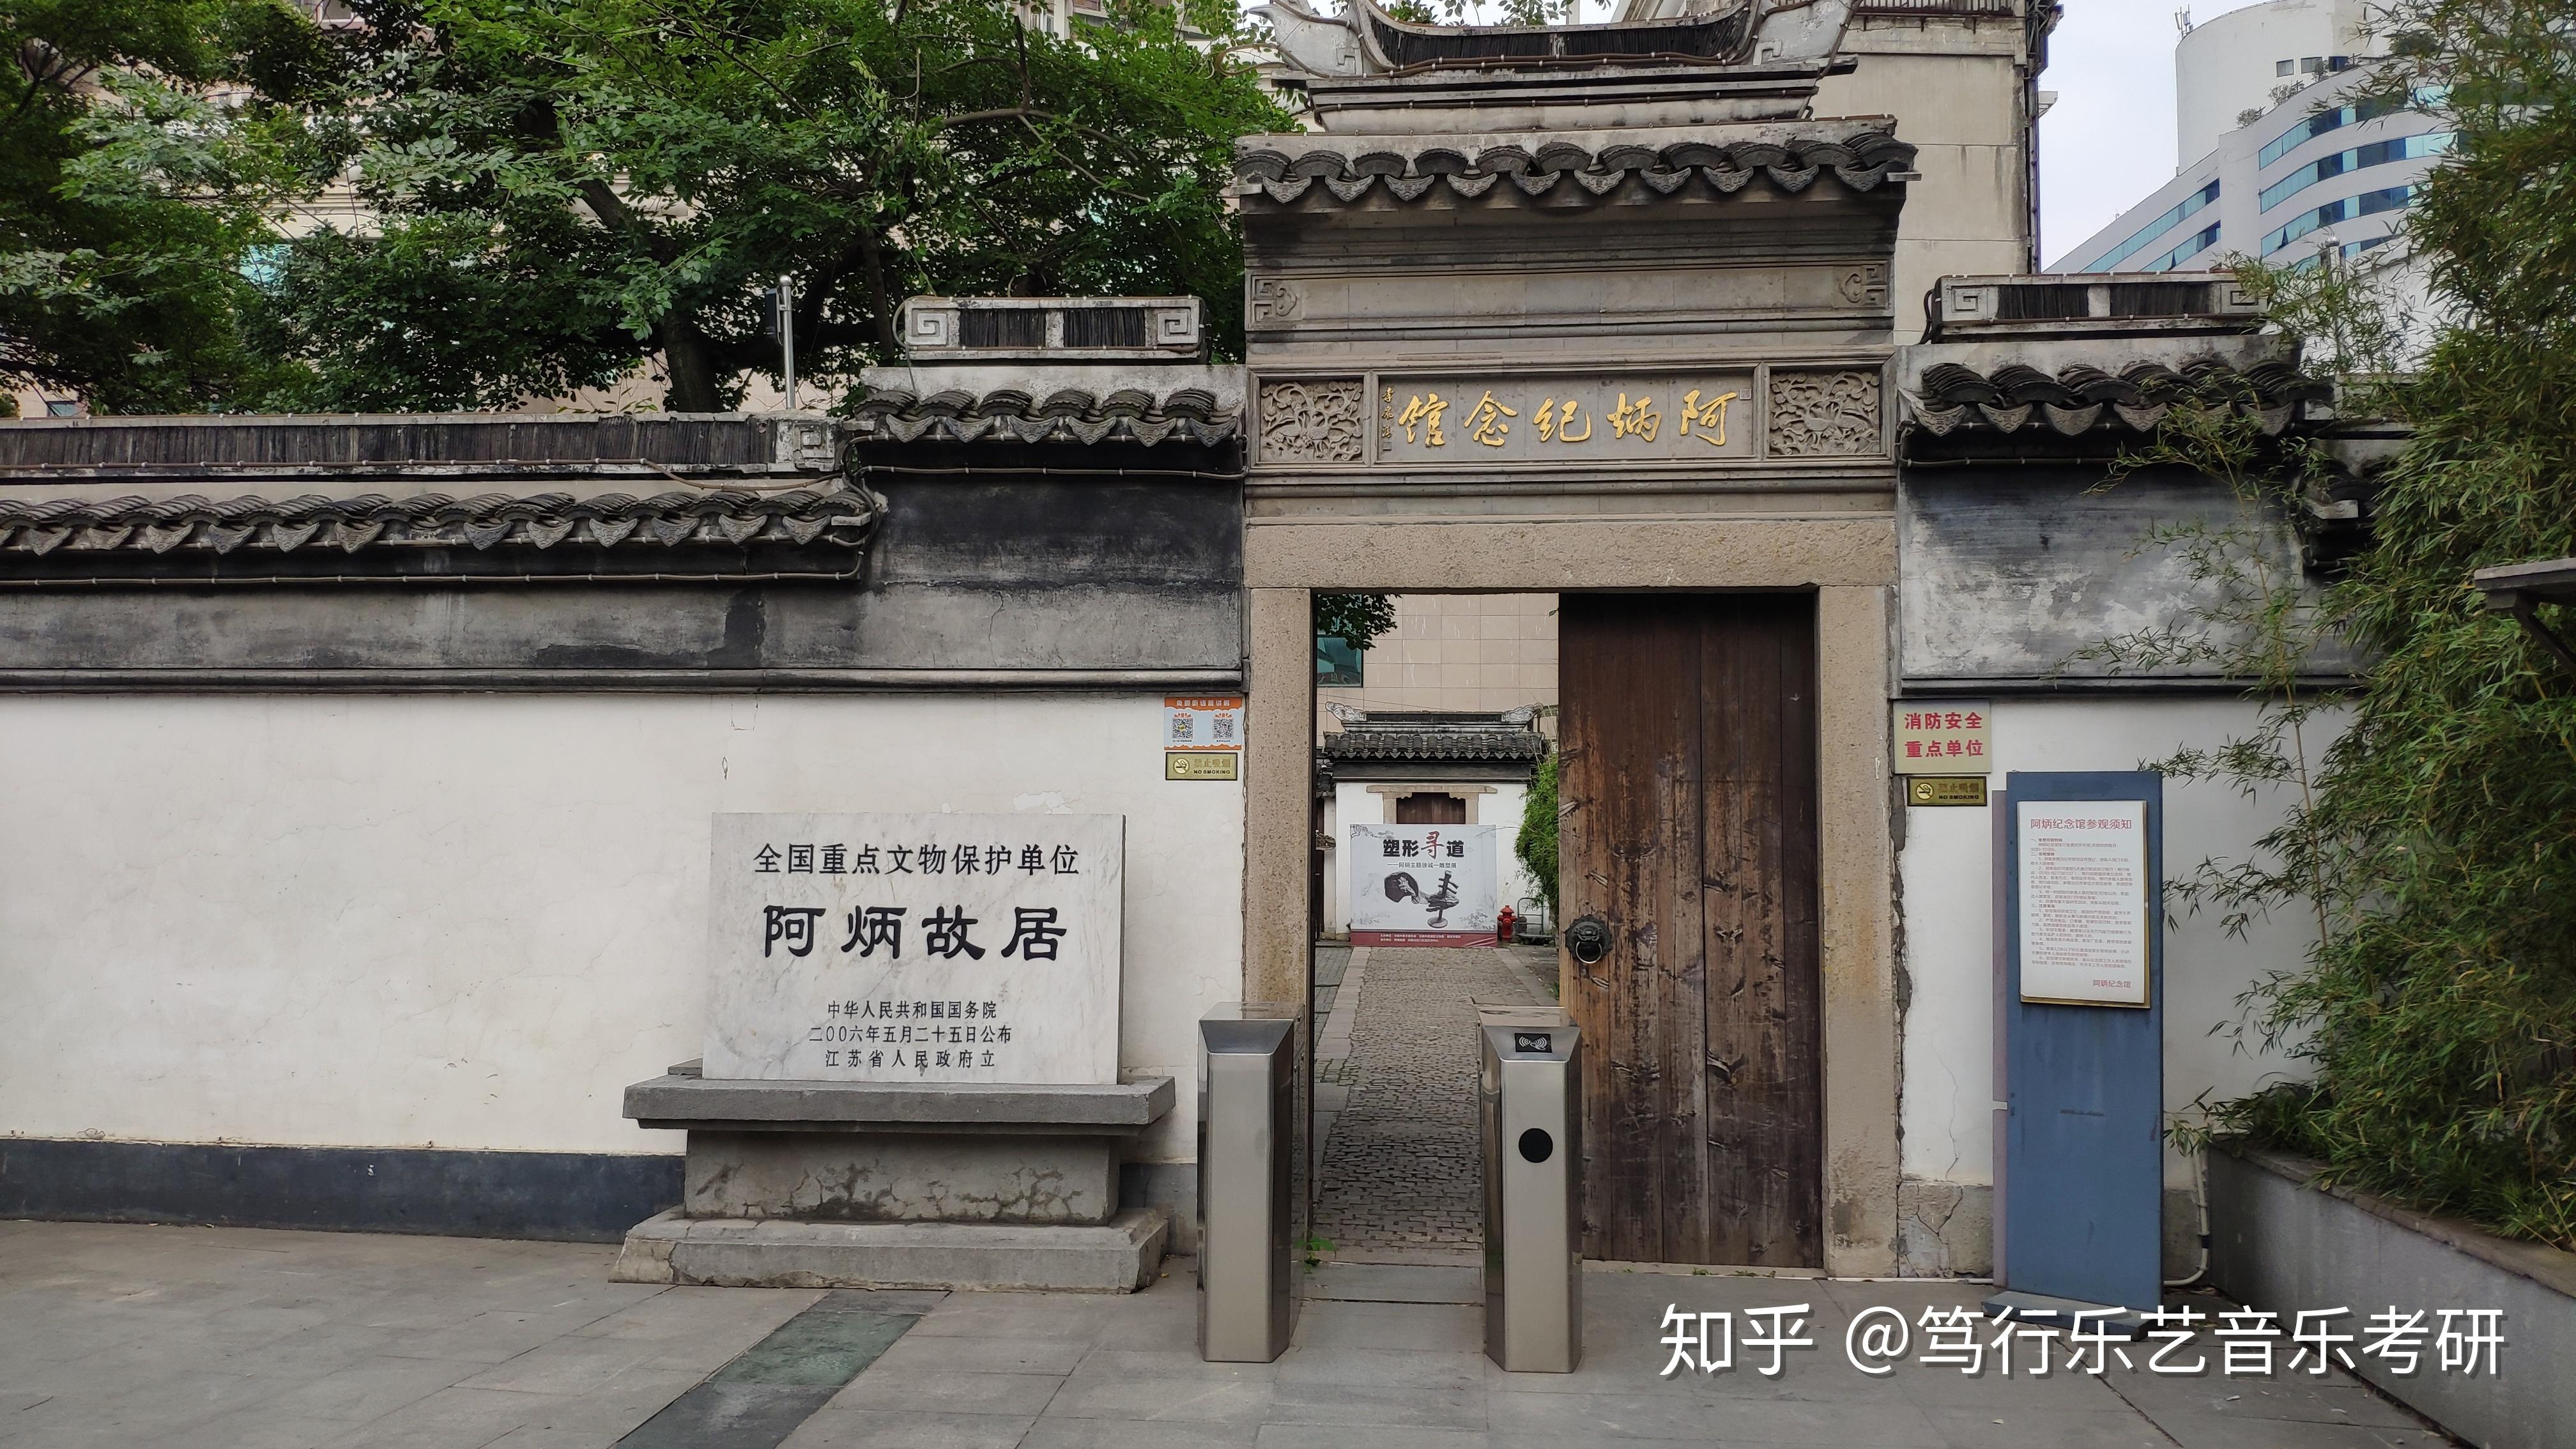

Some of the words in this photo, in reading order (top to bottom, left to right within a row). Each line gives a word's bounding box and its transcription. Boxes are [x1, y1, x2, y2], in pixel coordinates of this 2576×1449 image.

[1398, 388, 1738, 447] 阿炳纪念馆
[1904, 712, 1982, 730] 消防安全
[1904, 739, 1984, 758] 重点单位
[2030, 818, 2132, 829] 阿炳纪念馆参观须知
[1383, 831, 1464, 859] 塑形寻道
[753, 842, 1080, 876] 全国重点文物保护单位
[763, 905, 1067, 960] 阿炳故居
[2092, 979, 2131, 988] 阿炳纪念馆
[828, 1000, 997, 1019] 中华人民共和国国务院
[825, 1048, 995, 1069] 江苏省人民政府立
